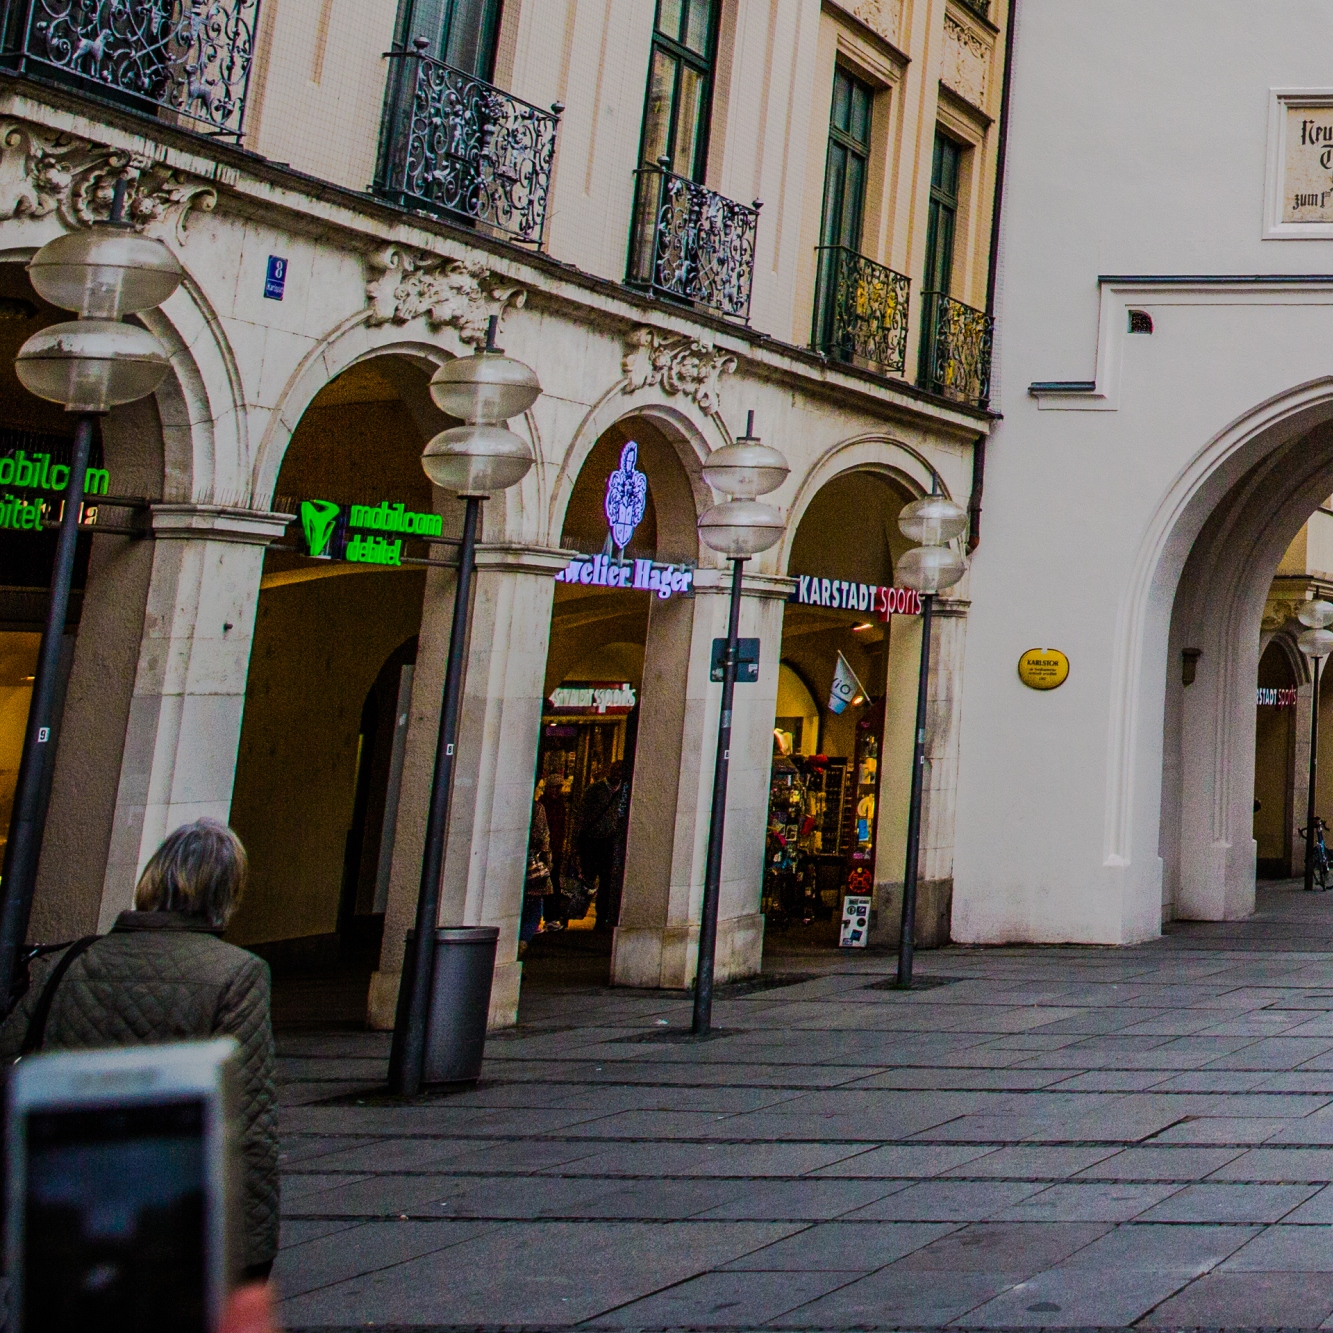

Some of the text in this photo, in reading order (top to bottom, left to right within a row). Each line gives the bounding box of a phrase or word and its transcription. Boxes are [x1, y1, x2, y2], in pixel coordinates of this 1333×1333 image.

[1293, 193, 1318, 210] zum
[275, 260, 283, 278] 8
[0, 451, 109, 495] obilcm
[0, 494, 43, 531] itel
[349, 502, 442, 536] mobilcom
[346, 534, 401, 566] debitel
[555, 554, 692, 599] welier Hager
[799, 574, 921, 622] KARSTADT sports
[594, 683, 636, 713] sports
[40, 729, 46, 740] 9
